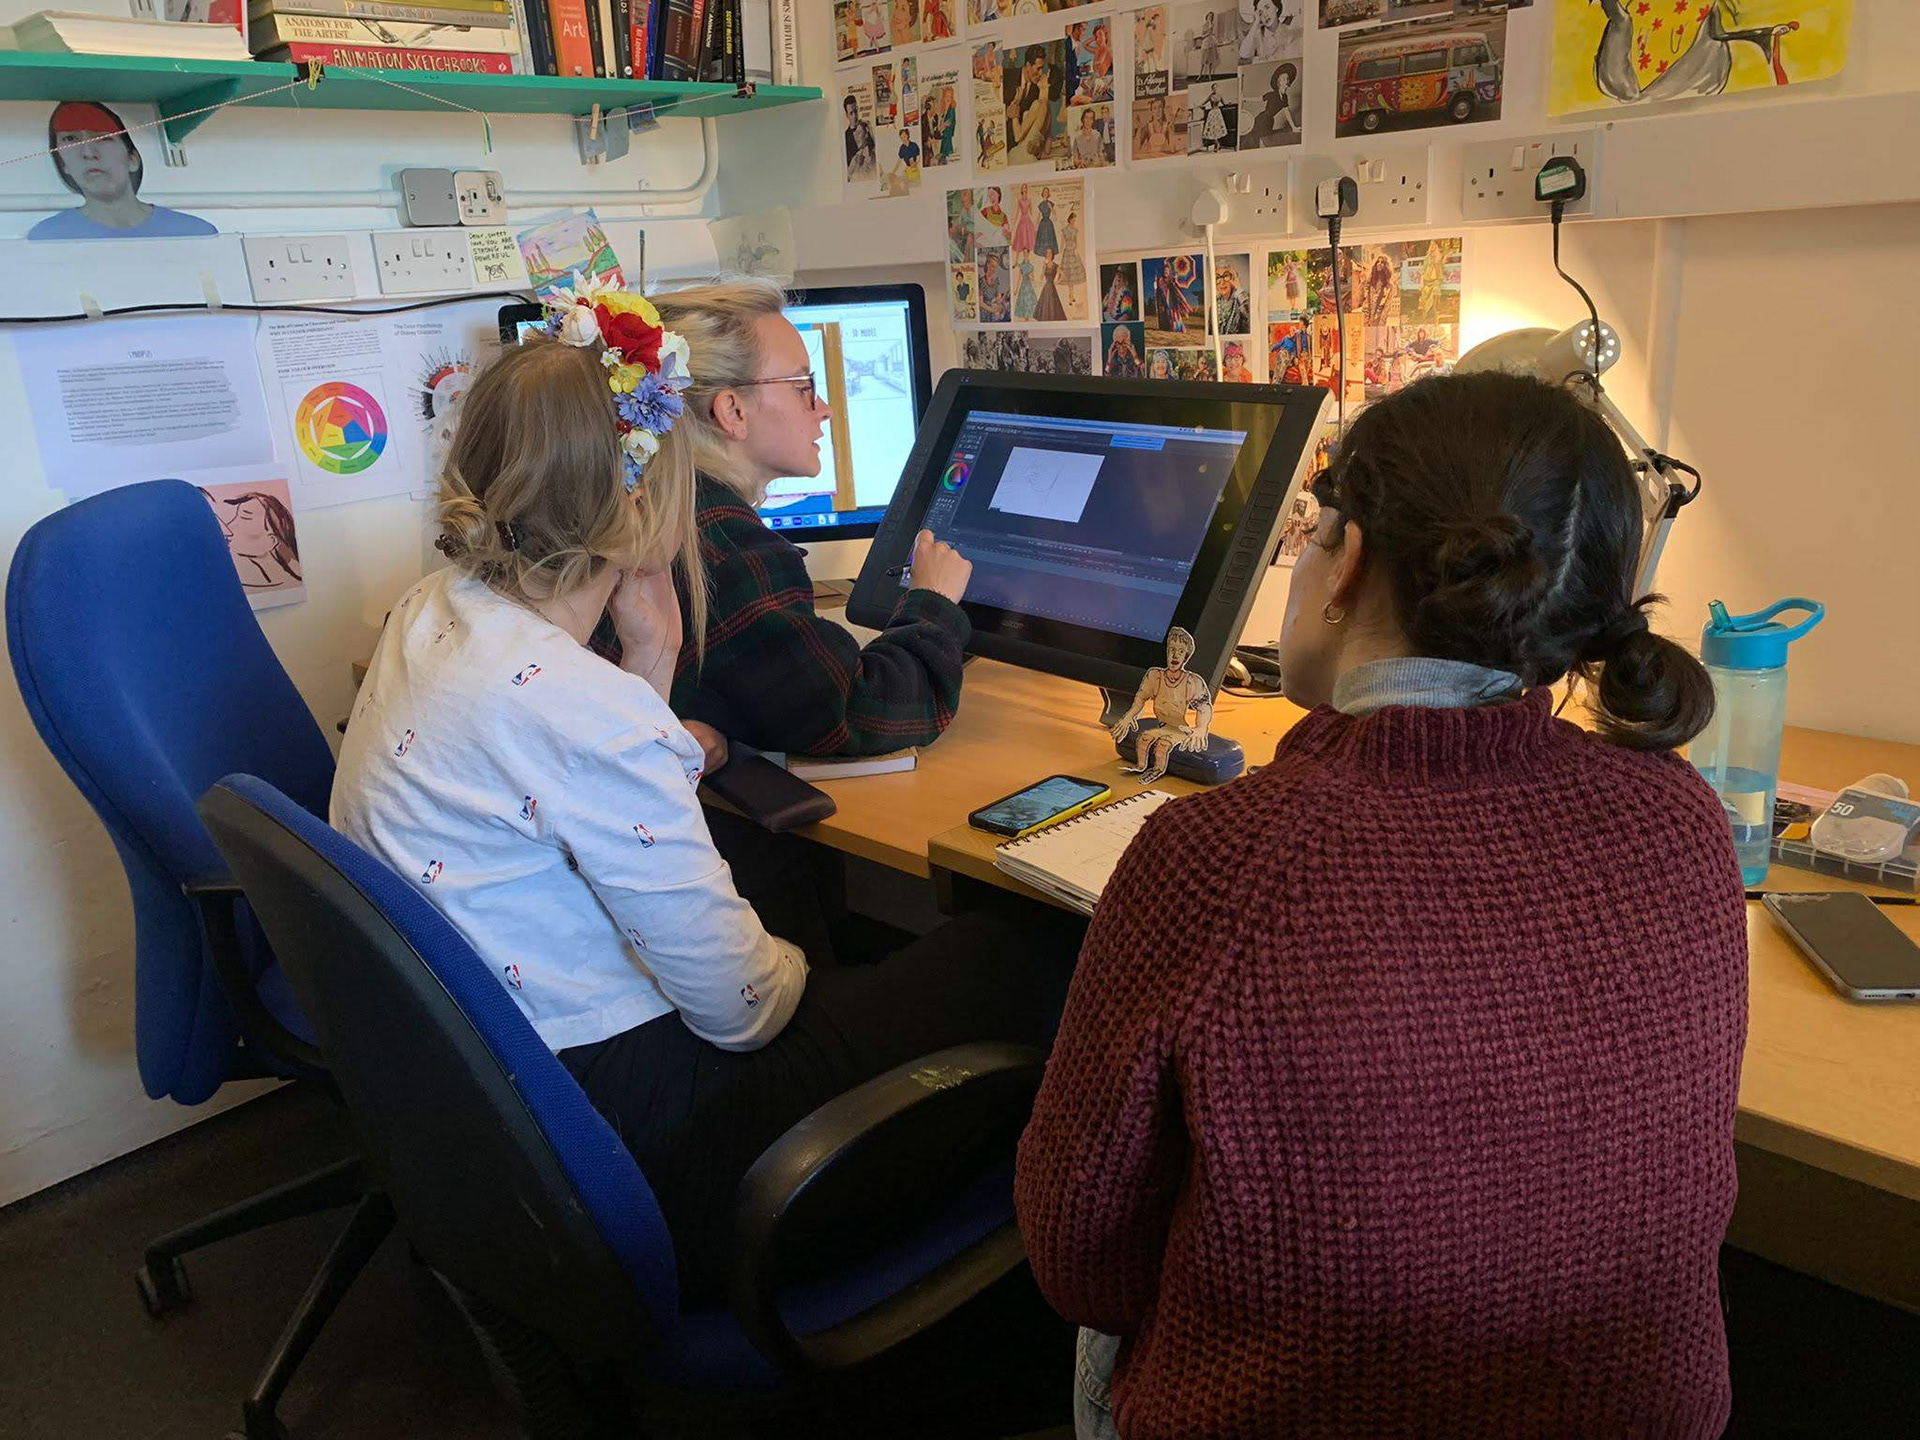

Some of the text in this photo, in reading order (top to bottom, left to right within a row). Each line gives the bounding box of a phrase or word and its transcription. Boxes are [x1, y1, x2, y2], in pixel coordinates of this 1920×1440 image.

[285, 17, 354, 30] ANATOMY FOR
[563, 20, 586, 38] Art
[705, 13, 714, 48] ANIMATION
[293, 28, 350, 39] THE ARTIST
[783, 15, 794, 51] SURVIVAL
[333, 49, 403, 70] ANIMATION
[406, 52, 487, 72] SKETCHBOOKS
[785, 53, 794, 67] KIT
[472, 246, 499, 255] STRONG
[474, 251, 511, 262] POWERFUL
[1830, 802, 1855, 816] 50
